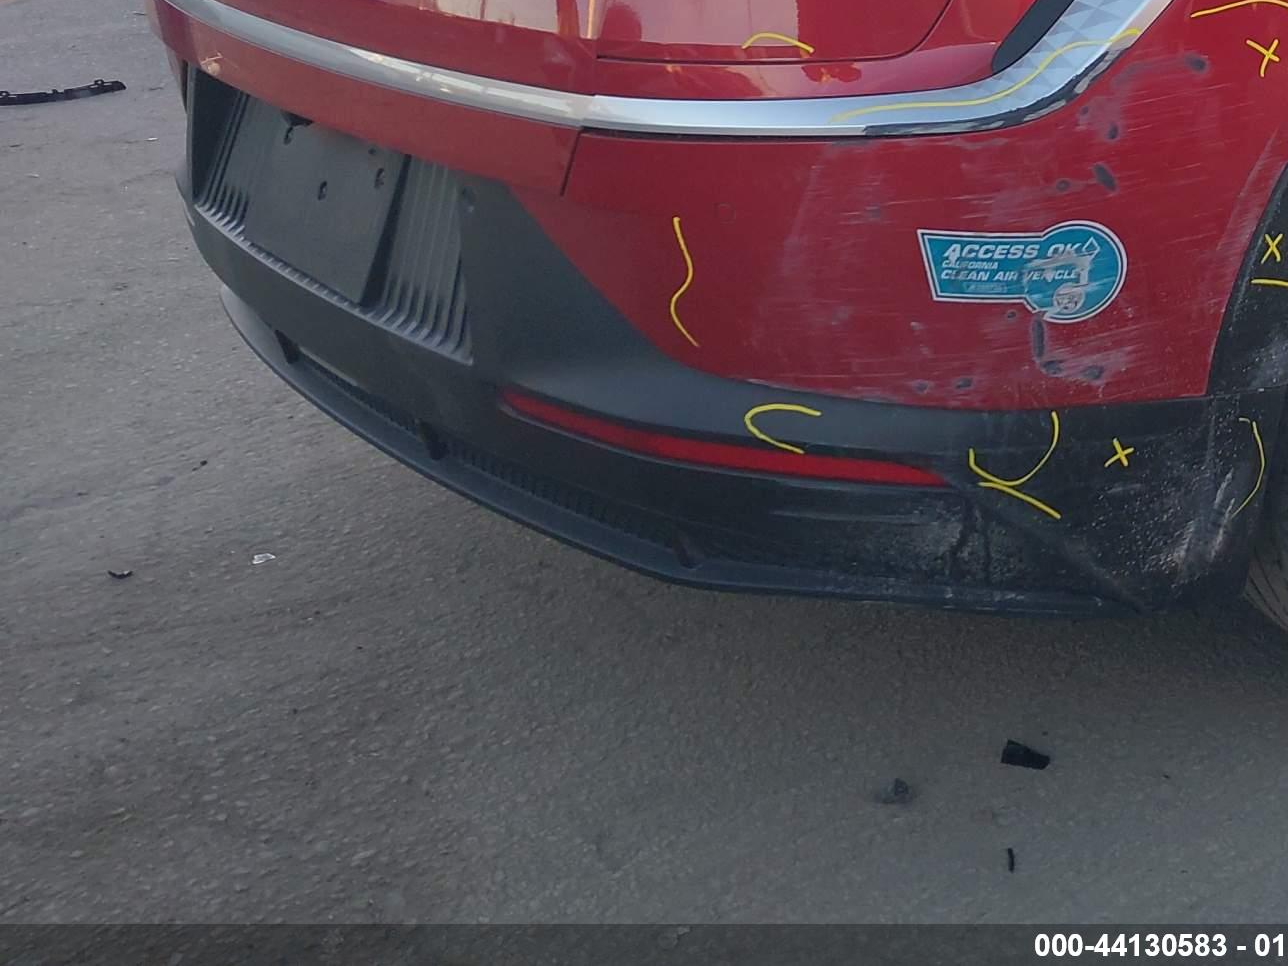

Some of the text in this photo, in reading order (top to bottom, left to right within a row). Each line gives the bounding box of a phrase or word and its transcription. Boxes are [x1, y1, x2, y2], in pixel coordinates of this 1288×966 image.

[942, 242, 1082, 259] ACCESS OK
[941, 269, 990, 282] CLEAN
[993, 270, 1018, 282] AIR
